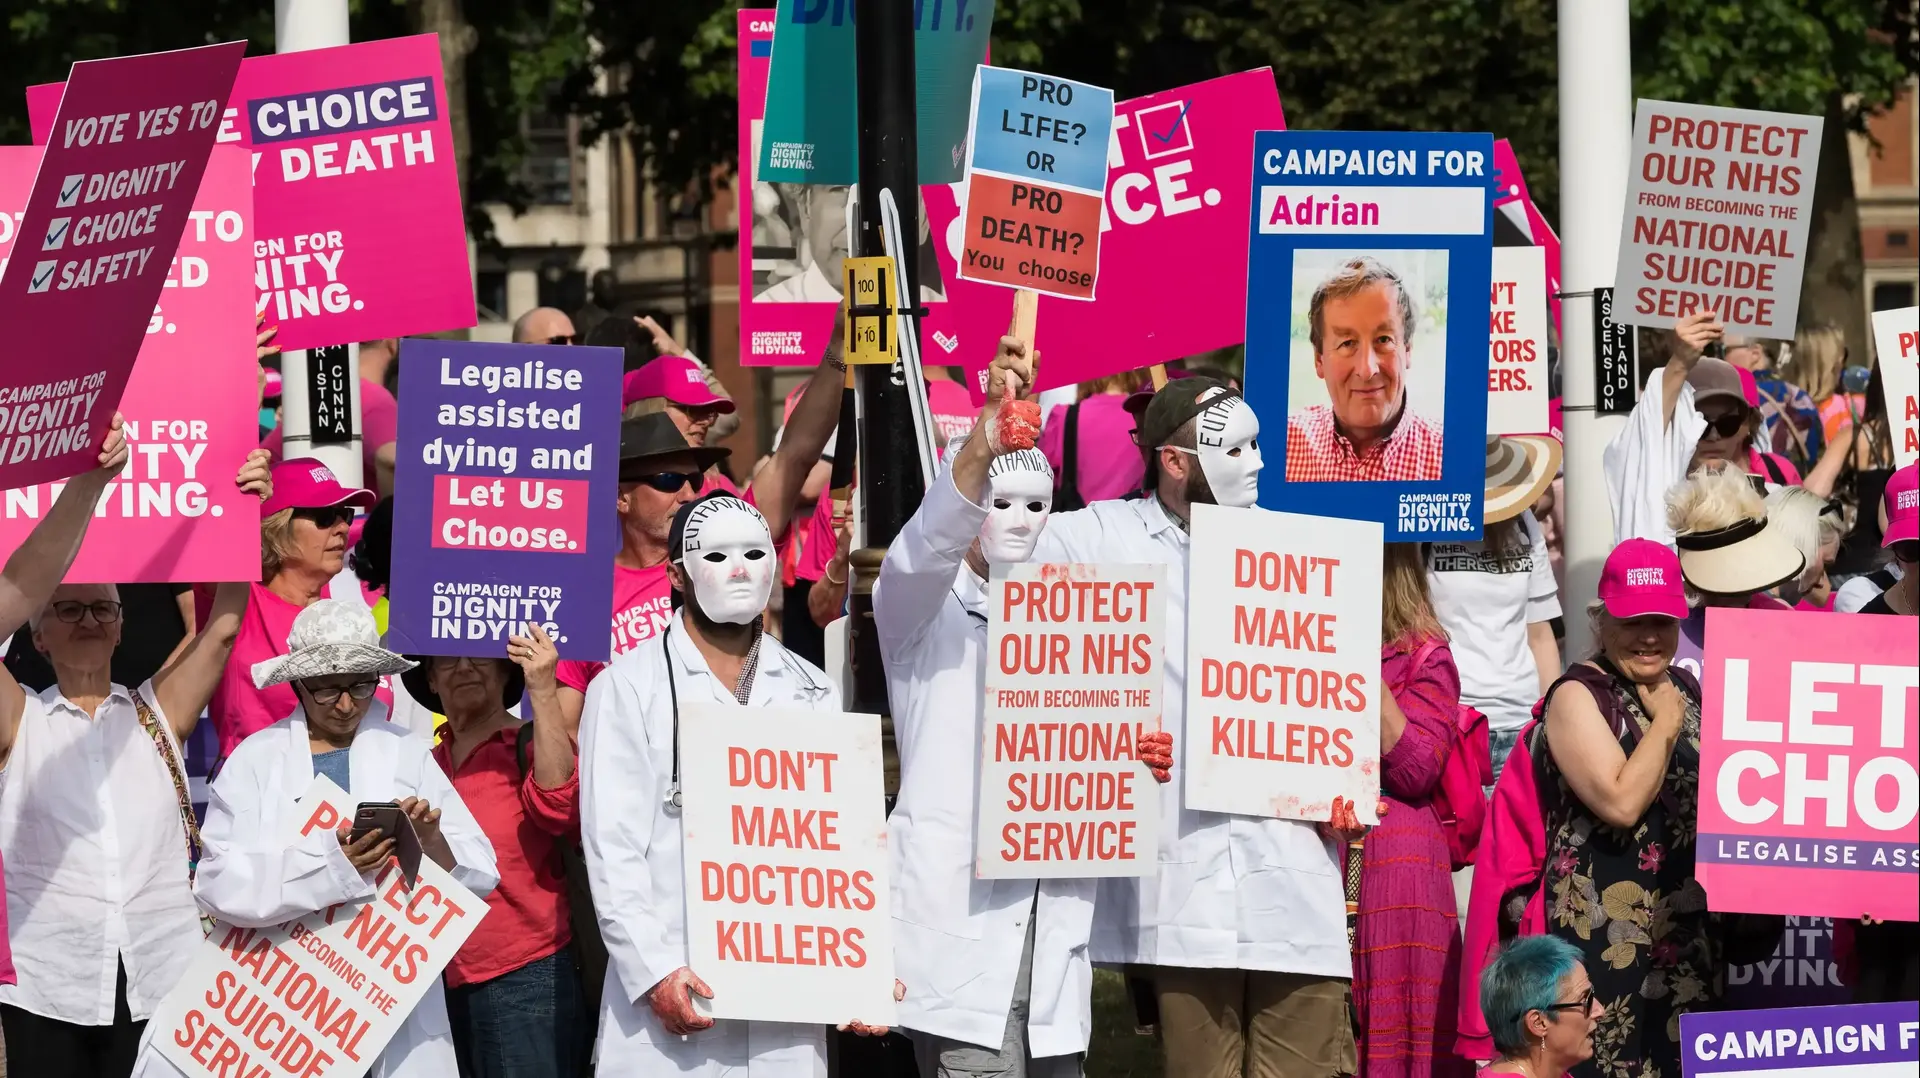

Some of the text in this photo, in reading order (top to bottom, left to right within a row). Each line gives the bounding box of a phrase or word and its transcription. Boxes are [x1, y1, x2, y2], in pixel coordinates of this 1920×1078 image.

[257, 82, 430, 137] CHOICE
[1021, 76, 1073, 107] PRO
[64, 99, 217, 149] VOTE YES TO
[1002, 109, 1087, 147] LIFE?
[1648, 114, 1808, 158] PROTECT
[281, 130, 435, 183] DEATH
[770, 158, 814, 170] IN DYING.
[771, 148, 813, 159] DIGNITY
[1026, 151, 1055, 174] OR
[1263, 149, 1484, 176] CAMPAIGN FOR
[85, 160, 186, 204] DIGNITY
[1642, 153, 1802, 196] OUR NHS
[1011, 184, 1062, 215] PRO
[1269, 194, 1379, 226] Adrian
[1638, 192, 1798, 220] FROM BECOMING THE
[73, 205, 162, 246] CHOICE
[189, 211, 243, 242] TO
[294, 230, 343, 253] FOR
[981, 217, 1085, 256] DEATH?
[1633, 215, 1795, 258] NATIONAL
[57, 246, 155, 290] SAFETY
[858, 279, 874, 293] 100
[966, 248, 1091, 288] You choose
[1643, 253, 1776, 291] SUICIDE
[1635, 287, 1775, 327] SERVICE
[752, 337, 802, 346] DIGNITY
[752, 346, 806, 355] IN DYING.
[865, 329, 875, 342] 10
[1601, 290, 1614, 410] ASCENSION
[440, 357, 582, 394] Legalise
[1616, 323, 1629, 390] SLAND
[0, 370, 106, 405] CAMPAIGN FOR
[315, 346, 329, 427] RISTAN
[332, 365, 345, 433] CUNHA
[152, 420, 208, 441] FOR
[437, 399, 581, 431] assisted
[10, 422, 91, 465] DYING.
[422, 438, 593, 475] dying and
[449, 478, 563, 510] Let Us
[1399, 493, 1471, 503] CAMPAIGN FOR
[1399, 502, 1471, 517] DIGNITY
[442, 517, 578, 550] Choose.
[1398, 517, 1475, 532] IN DYING.
[1234, 548, 1340, 597] DON'T
[1436, 558, 1484, 571] THERE
[1627, 571, 1663, 579] DIGNITY
[1627, 578, 1636, 586] IN
[432, 595, 561, 621] DIGNITY
[433, 582, 562, 599] CAMPAIGN FOR
[1003, 581, 1154, 622] PROTECT
[431, 618, 568, 643] IN DYING.
[612, 596, 672, 628] AMPAIG
[1234, 604, 1337, 653] MAKE
[1000, 633, 1152, 675] OUR NHS
[997, 689, 1151, 708] FROM BECOMING THE
[1201, 657, 1367, 713] DOCTORS
[1722, 658, 1919, 748] LET
[1212, 715, 1354, 768] KILLERS
[728, 747, 838, 792] DON'T
[1006, 771, 1135, 812] SUICIDE
[1716, 749, 1919, 831] CHO
[731, 805, 840, 851] MAKE
[1000, 821, 1137, 862] SERVICE
[1718, 840, 1857, 865] LEGALISE
[701, 861, 876, 911] DOCTORS
[343, 903, 429, 985] NHS
[716, 920, 867, 968] KILLERS
[289, 922, 398, 1016] BECOMING THE
[219, 927, 371, 1062] NATIONAL
[205, 970, 335, 1078] SUICIDE
[1694, 1023, 1886, 1061] CAMPAIGN
